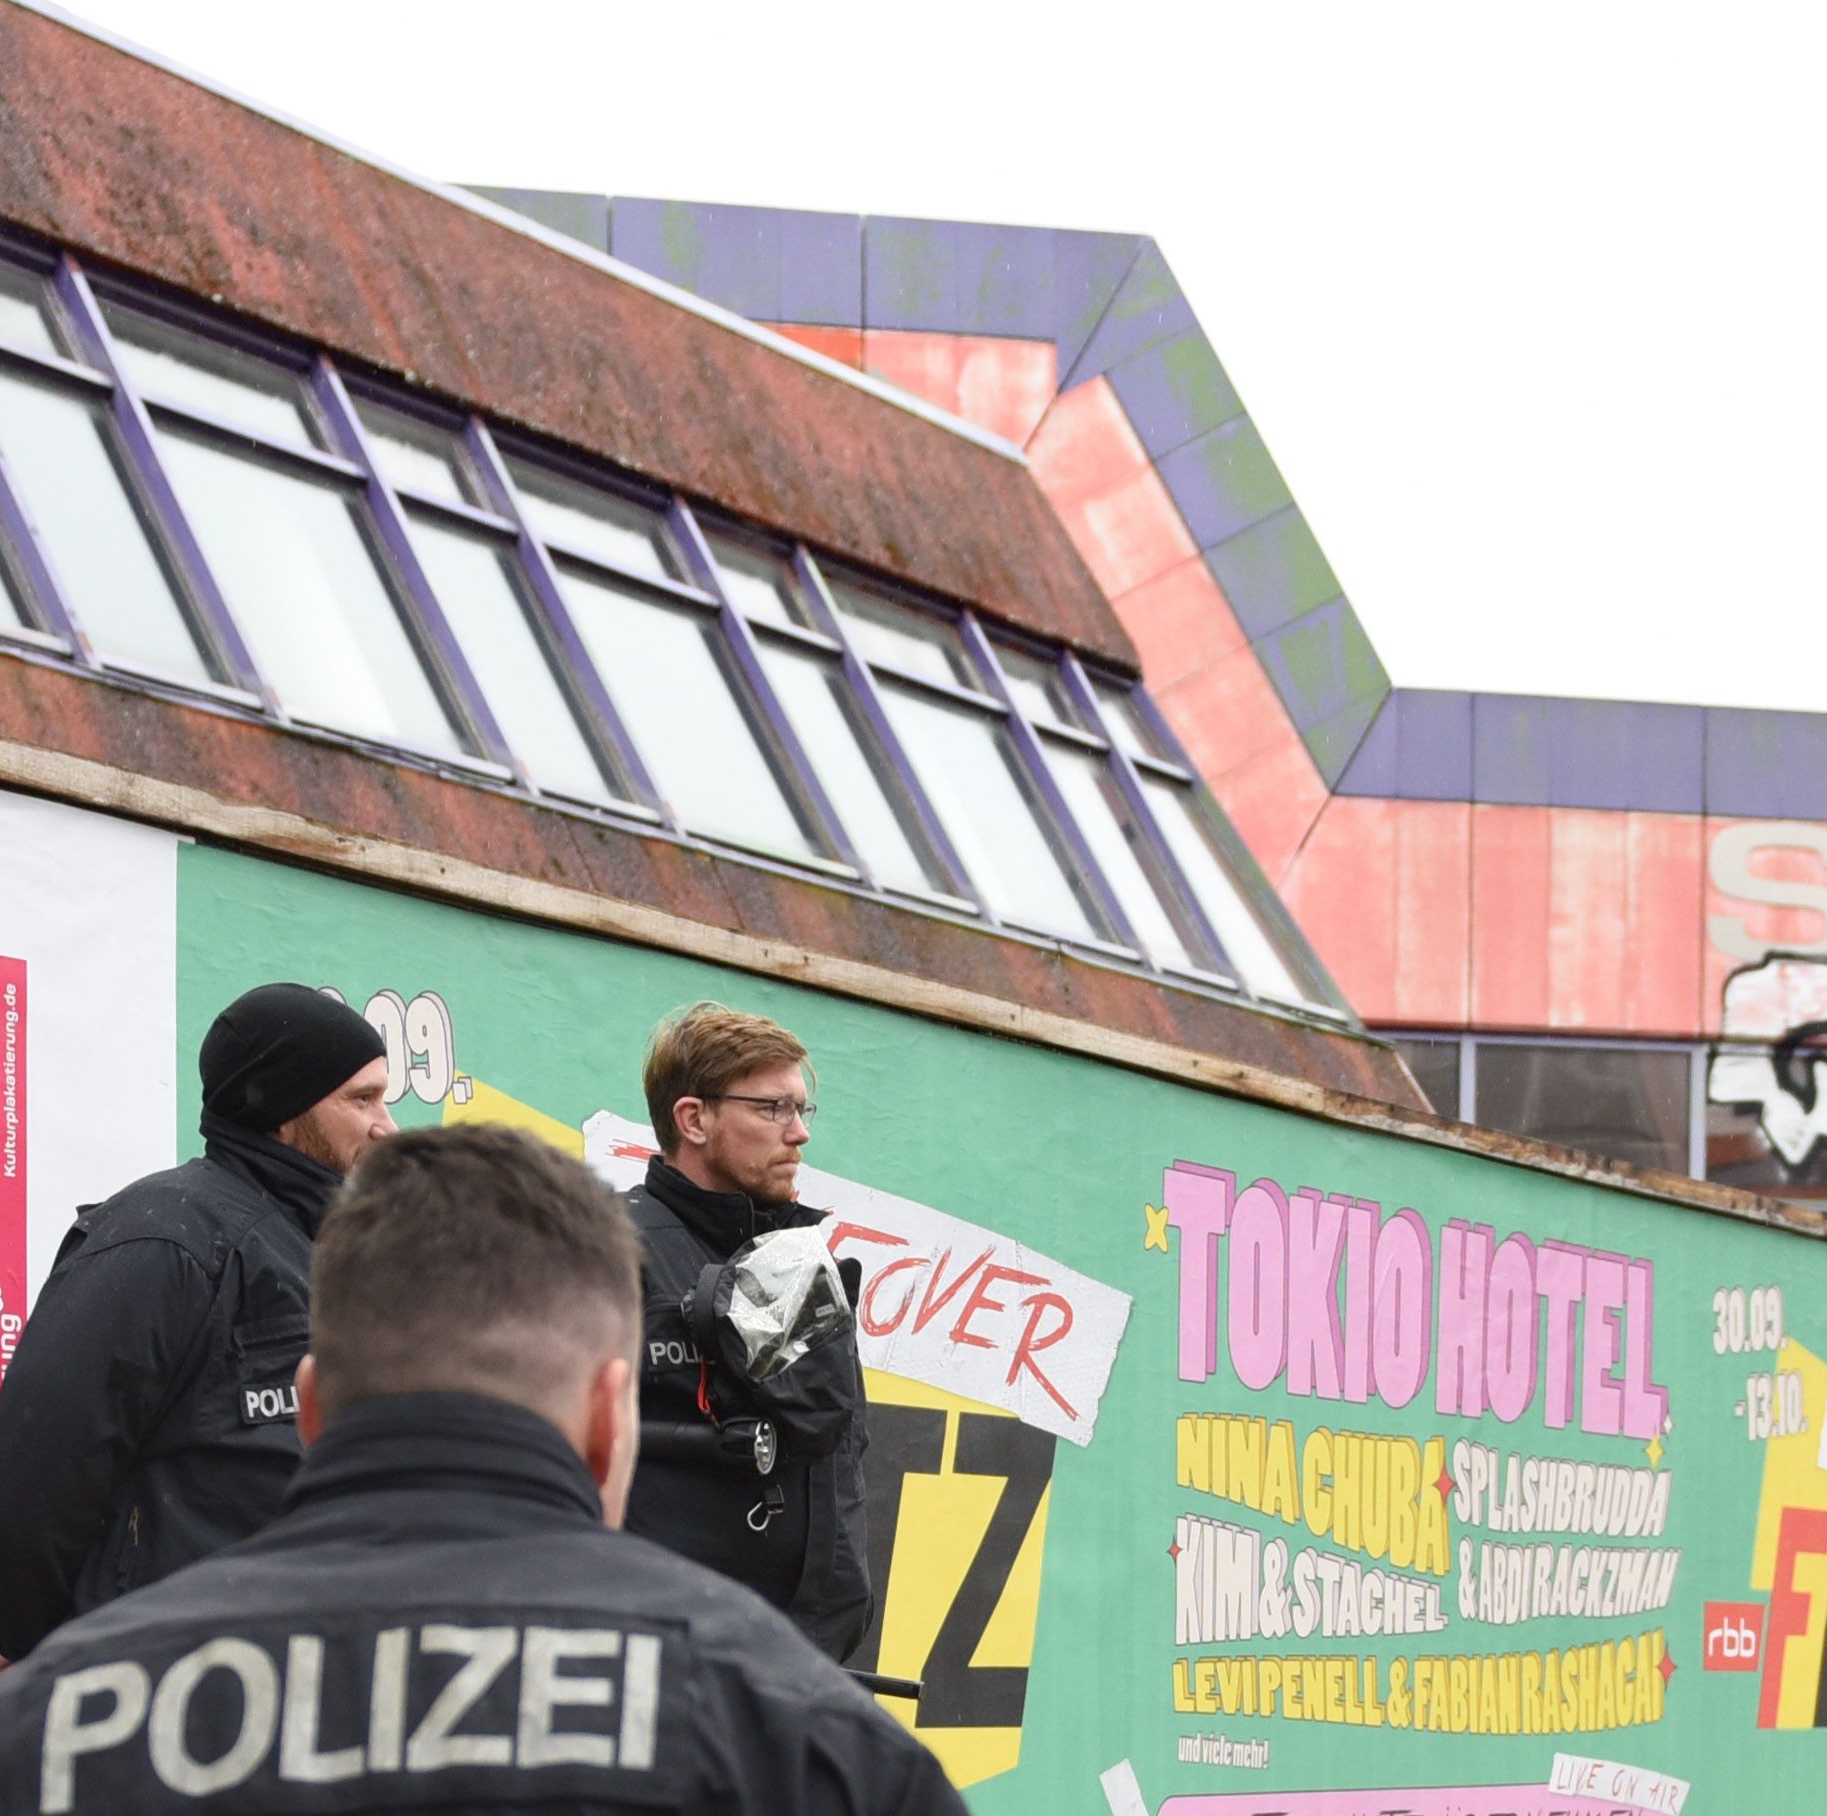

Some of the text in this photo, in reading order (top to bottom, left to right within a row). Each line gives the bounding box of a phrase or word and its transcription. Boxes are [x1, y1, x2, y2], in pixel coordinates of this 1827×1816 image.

[3, 983, 17, 1178] Kulturplakatierung.de
[1163, 1159, 1669, 1441] TOKIO HOTEL
[1712, 1284, 1789, 1355] 30.09.
[246, 1385, 301, 1418] POLI
[1176, 1412, 1452, 1577] NINA CHUBA
[1453, 1437, 1673, 1537] SPLASHBRUDDA
[1174, 1512, 1449, 1647] KIM & STACHEL
[1458, 1535, 1478, 1620] &
[1708, 1616, 1757, 1658] rbb
[1386, 1654, 1414, 1729] &
[1178, 1730, 1270, 1771] und viele mehr!
[1557, 1760, 1679, 1816] LIVE ON AIR
